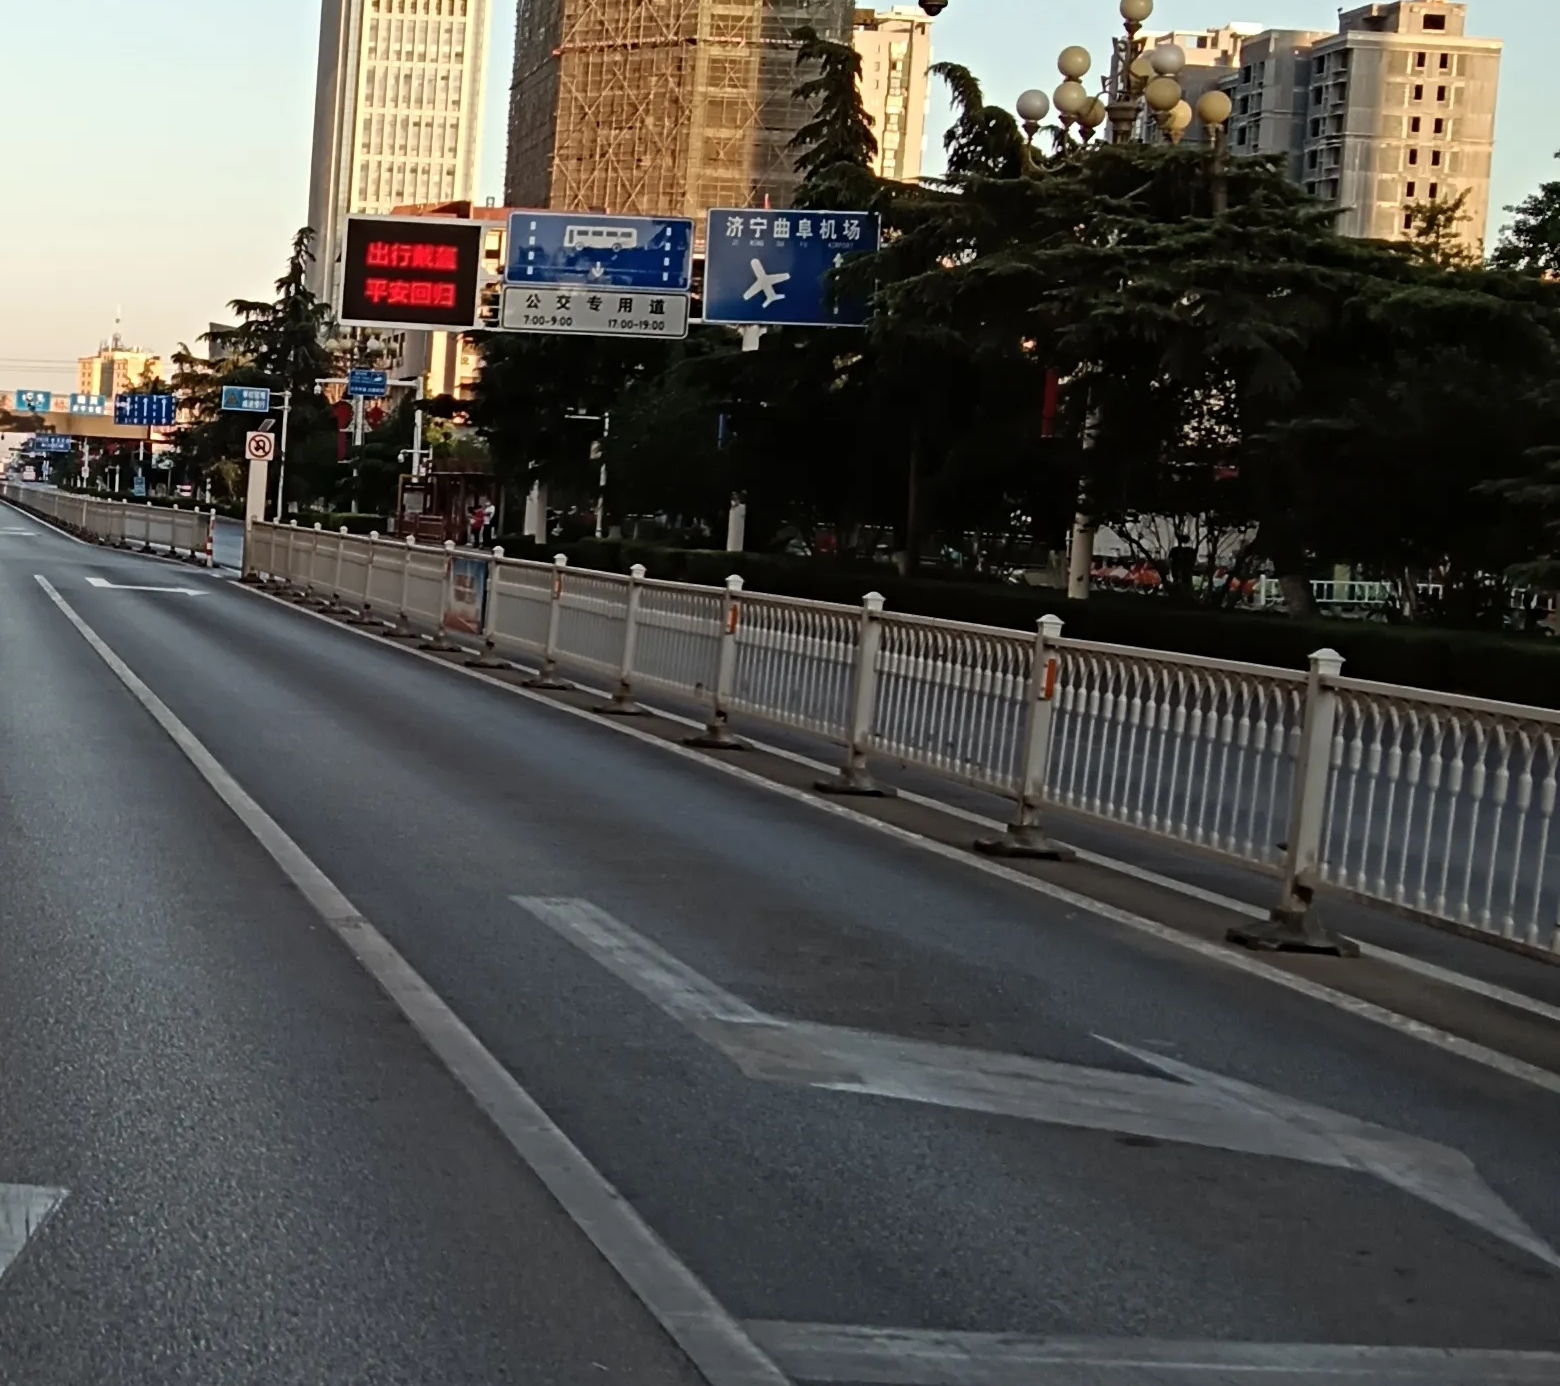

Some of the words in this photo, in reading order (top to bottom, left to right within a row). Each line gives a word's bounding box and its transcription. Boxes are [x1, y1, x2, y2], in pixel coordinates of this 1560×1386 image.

[726, 216, 861, 240] 济宁曲阜机场
[364, 277, 456, 307] 平安回归
[526, 293, 665, 315] 公交专用道
[523, 315, 573, 327] 7:00-9:00
[608, 319, 665, 331] 17:00-19:00
